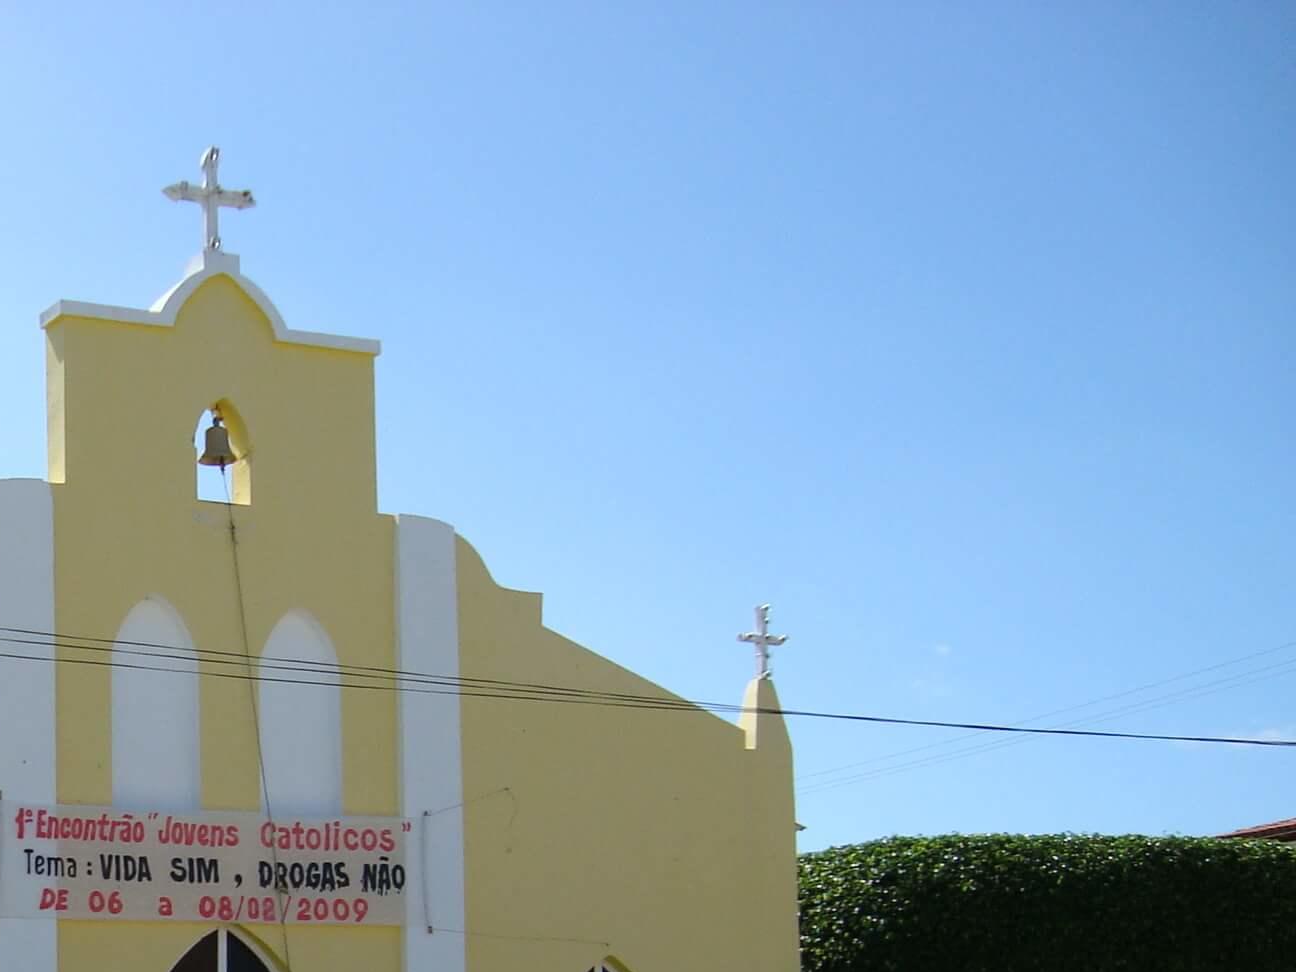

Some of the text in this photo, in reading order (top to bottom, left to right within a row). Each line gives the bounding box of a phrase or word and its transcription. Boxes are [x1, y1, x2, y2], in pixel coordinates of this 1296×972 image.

[36, 809, 145, 843] Encontrão
[99, 854, 152, 882] VIDA
[258, 860, 350, 892] DROGAS
[360, 856, 405, 896] NÃO
[39, 888, 70, 910] DE
[88, 890, 124, 914] 06
[158, 896, 173, 916] a
